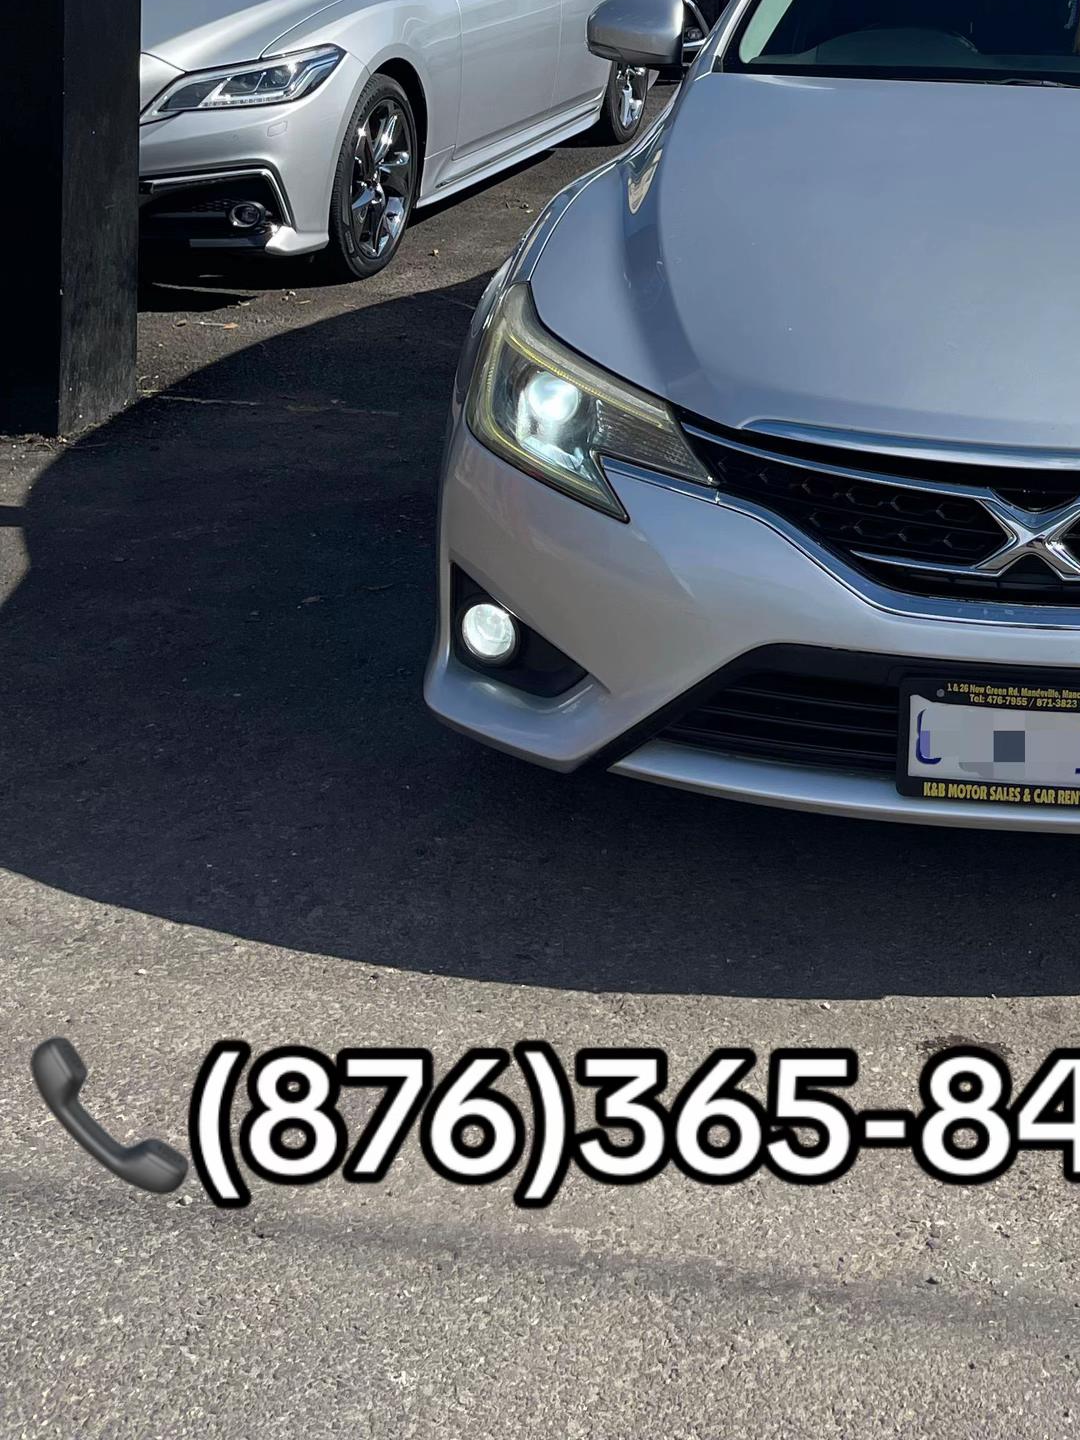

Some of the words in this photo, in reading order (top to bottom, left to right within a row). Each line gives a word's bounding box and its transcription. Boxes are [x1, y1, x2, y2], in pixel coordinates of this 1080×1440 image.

[947, 682, 953, 692] 1
[953, 683, 959, 692] &
[986, 685, 1007, 696] Green
[1008, 687, 1020, 697] Rd.
[1021, 688, 1061, 699] Mandeville,
[923, 782, 946, 797] K&B
[947, 783, 988, 800] MOTOR
[989, 786, 1021, 802] SALES
[1023, 788, 1031, 802] &
[1033, 789, 1055, 803] CAR
